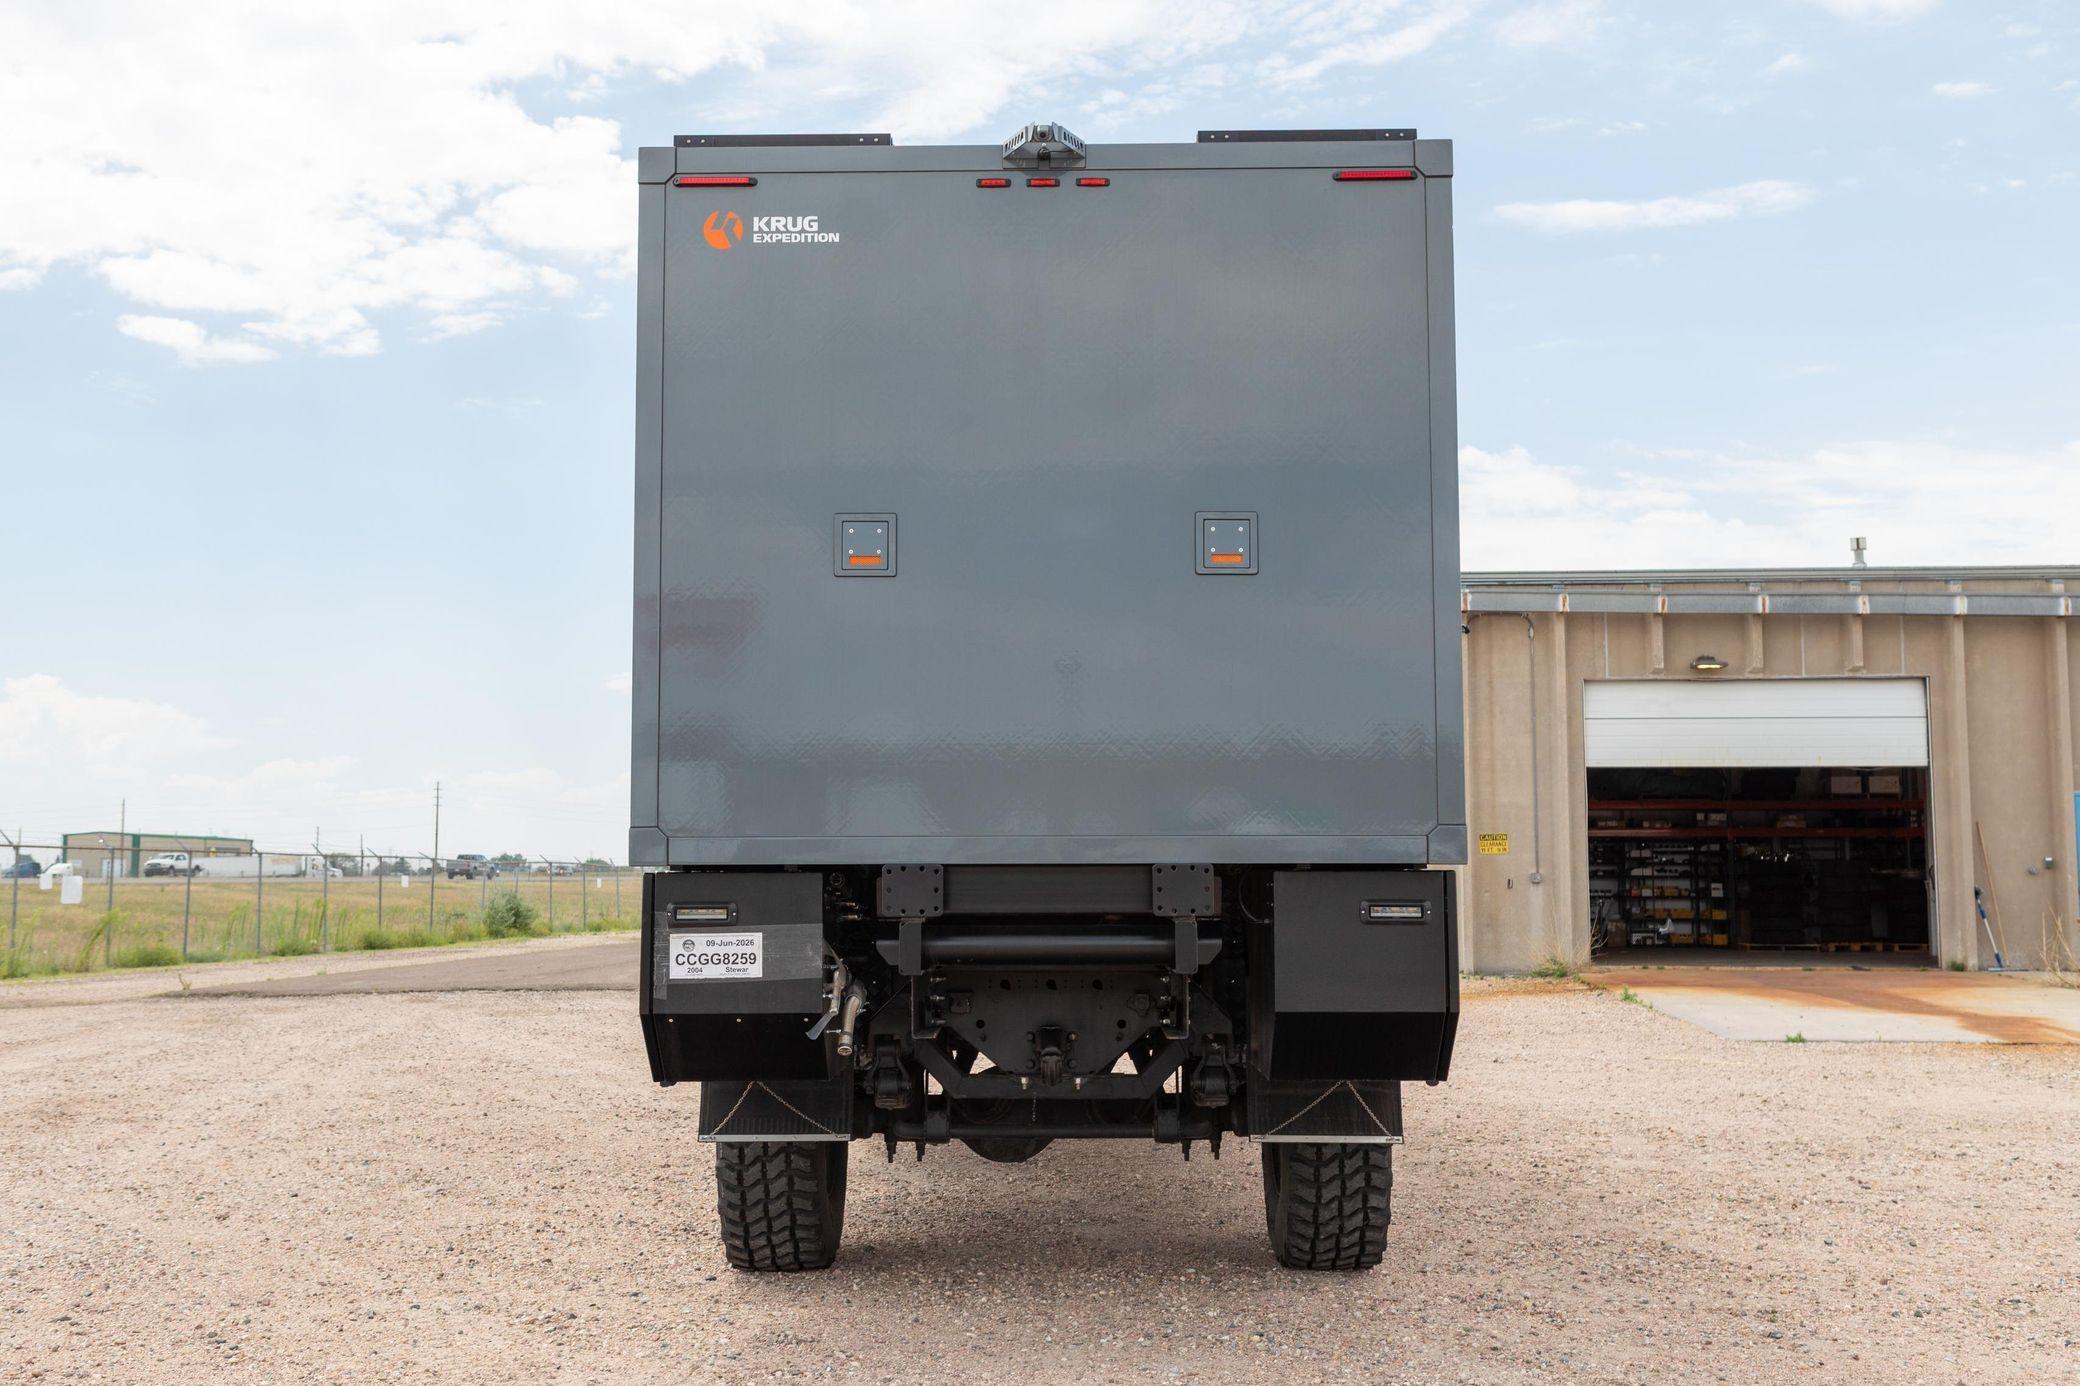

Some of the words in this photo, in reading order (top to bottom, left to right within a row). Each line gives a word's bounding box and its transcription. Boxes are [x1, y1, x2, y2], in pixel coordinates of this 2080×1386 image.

[753, 216, 818, 232] KRUG
[753, 233, 840, 243] EXPEDITION
[706, 939, 755, 947] 09-Jun-2026
[675, 952, 757, 966] CCGG8259
[725, 966, 749, 974] Stewar
